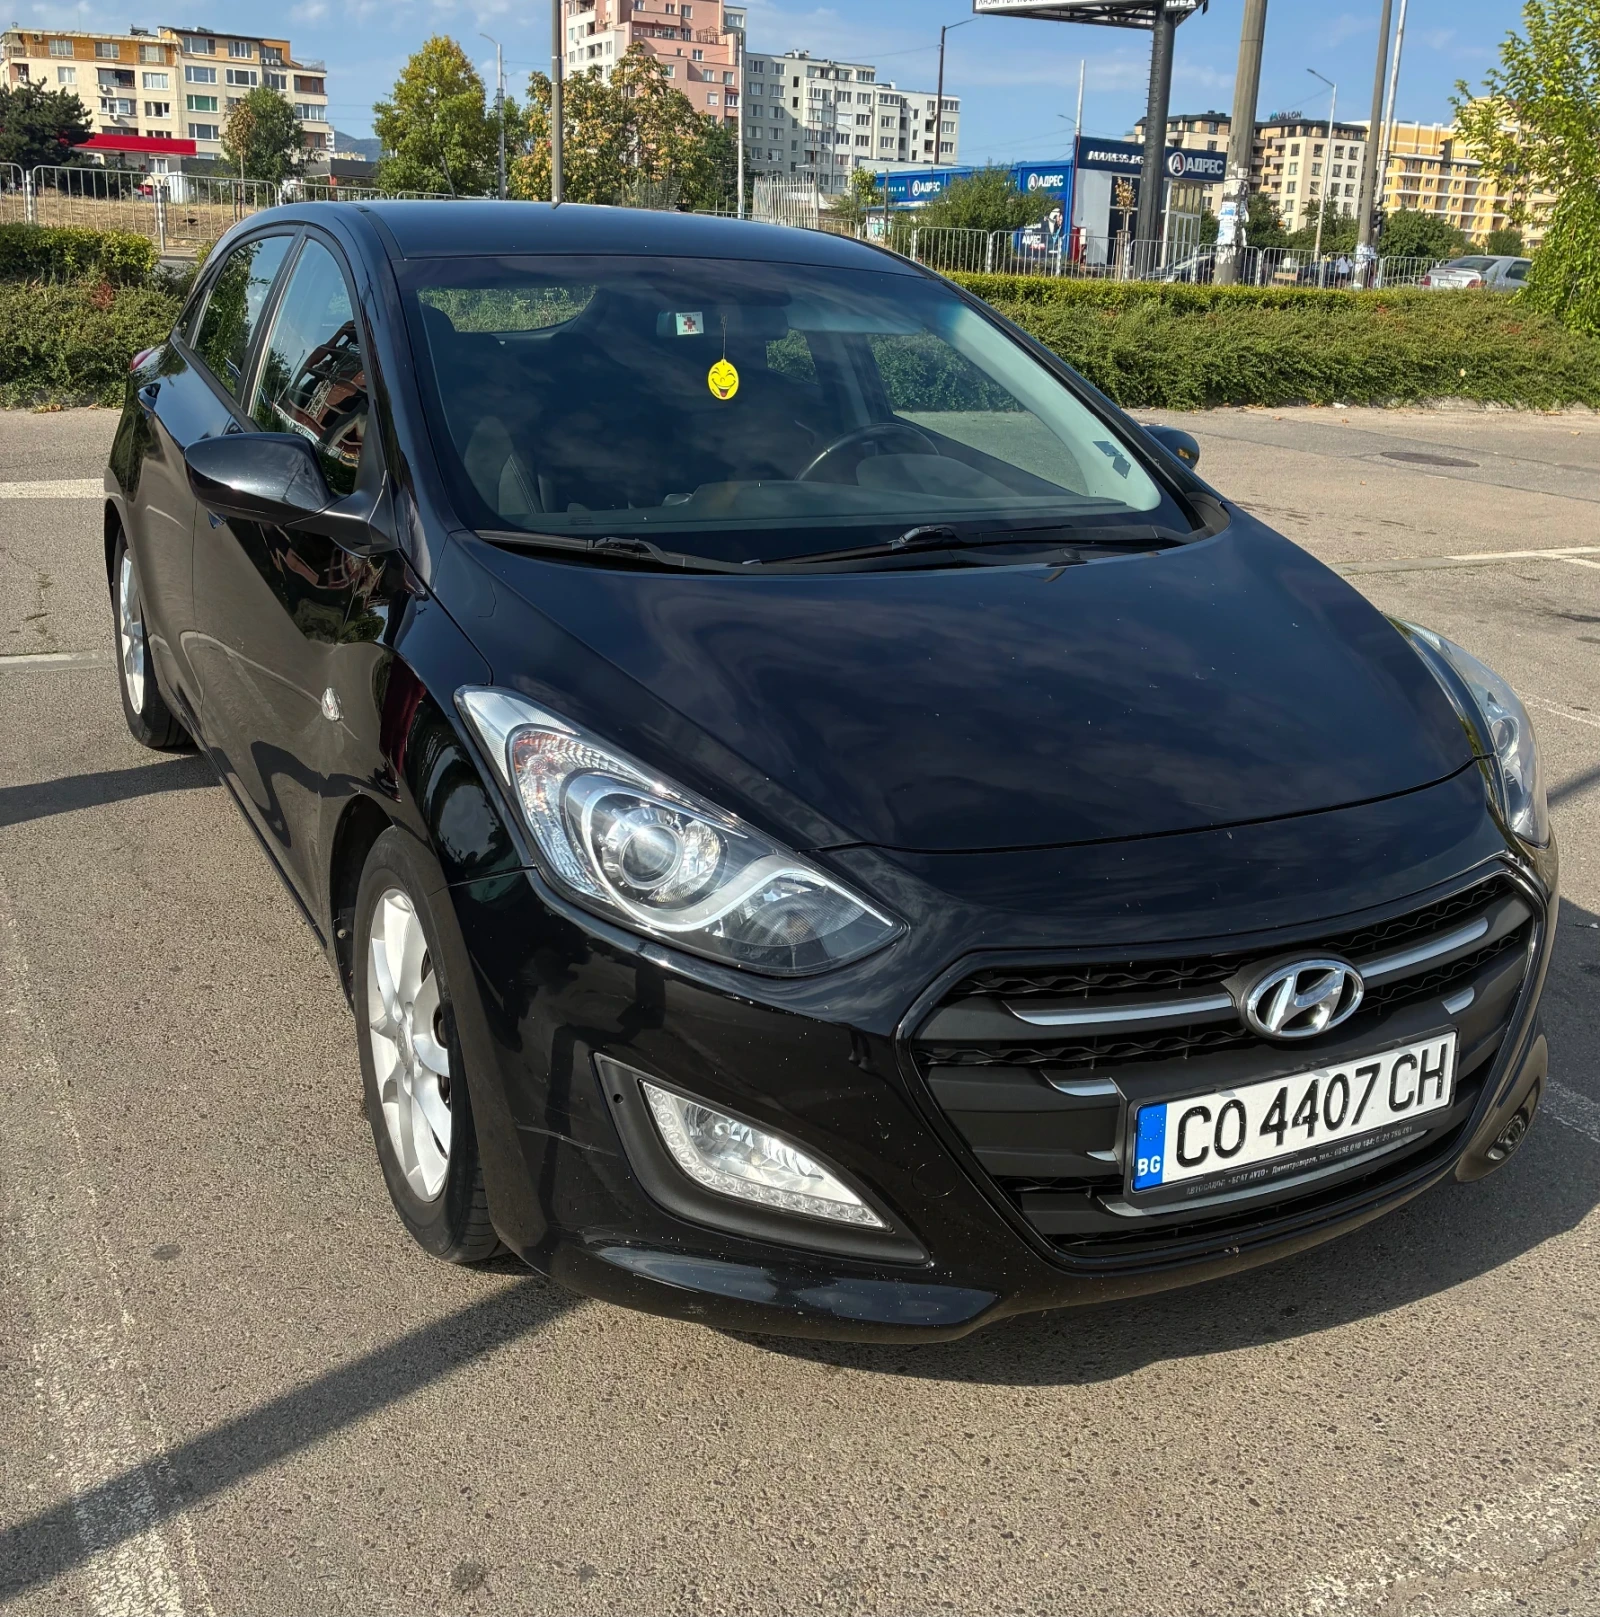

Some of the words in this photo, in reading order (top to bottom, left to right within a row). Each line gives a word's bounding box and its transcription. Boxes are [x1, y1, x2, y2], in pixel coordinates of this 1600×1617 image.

[1269, 110, 1302, 120] AVALON
[1185, 156, 1224, 174] АДРЕС
[1038, 174, 1064, 187] АДРЕС
[1176, 1099, 1247, 1168] CO
[1259, 1062, 1381, 1147] 4407
[1388, 1043, 1448, 1113] CH
[1137, 1156, 1161, 1177] BG
